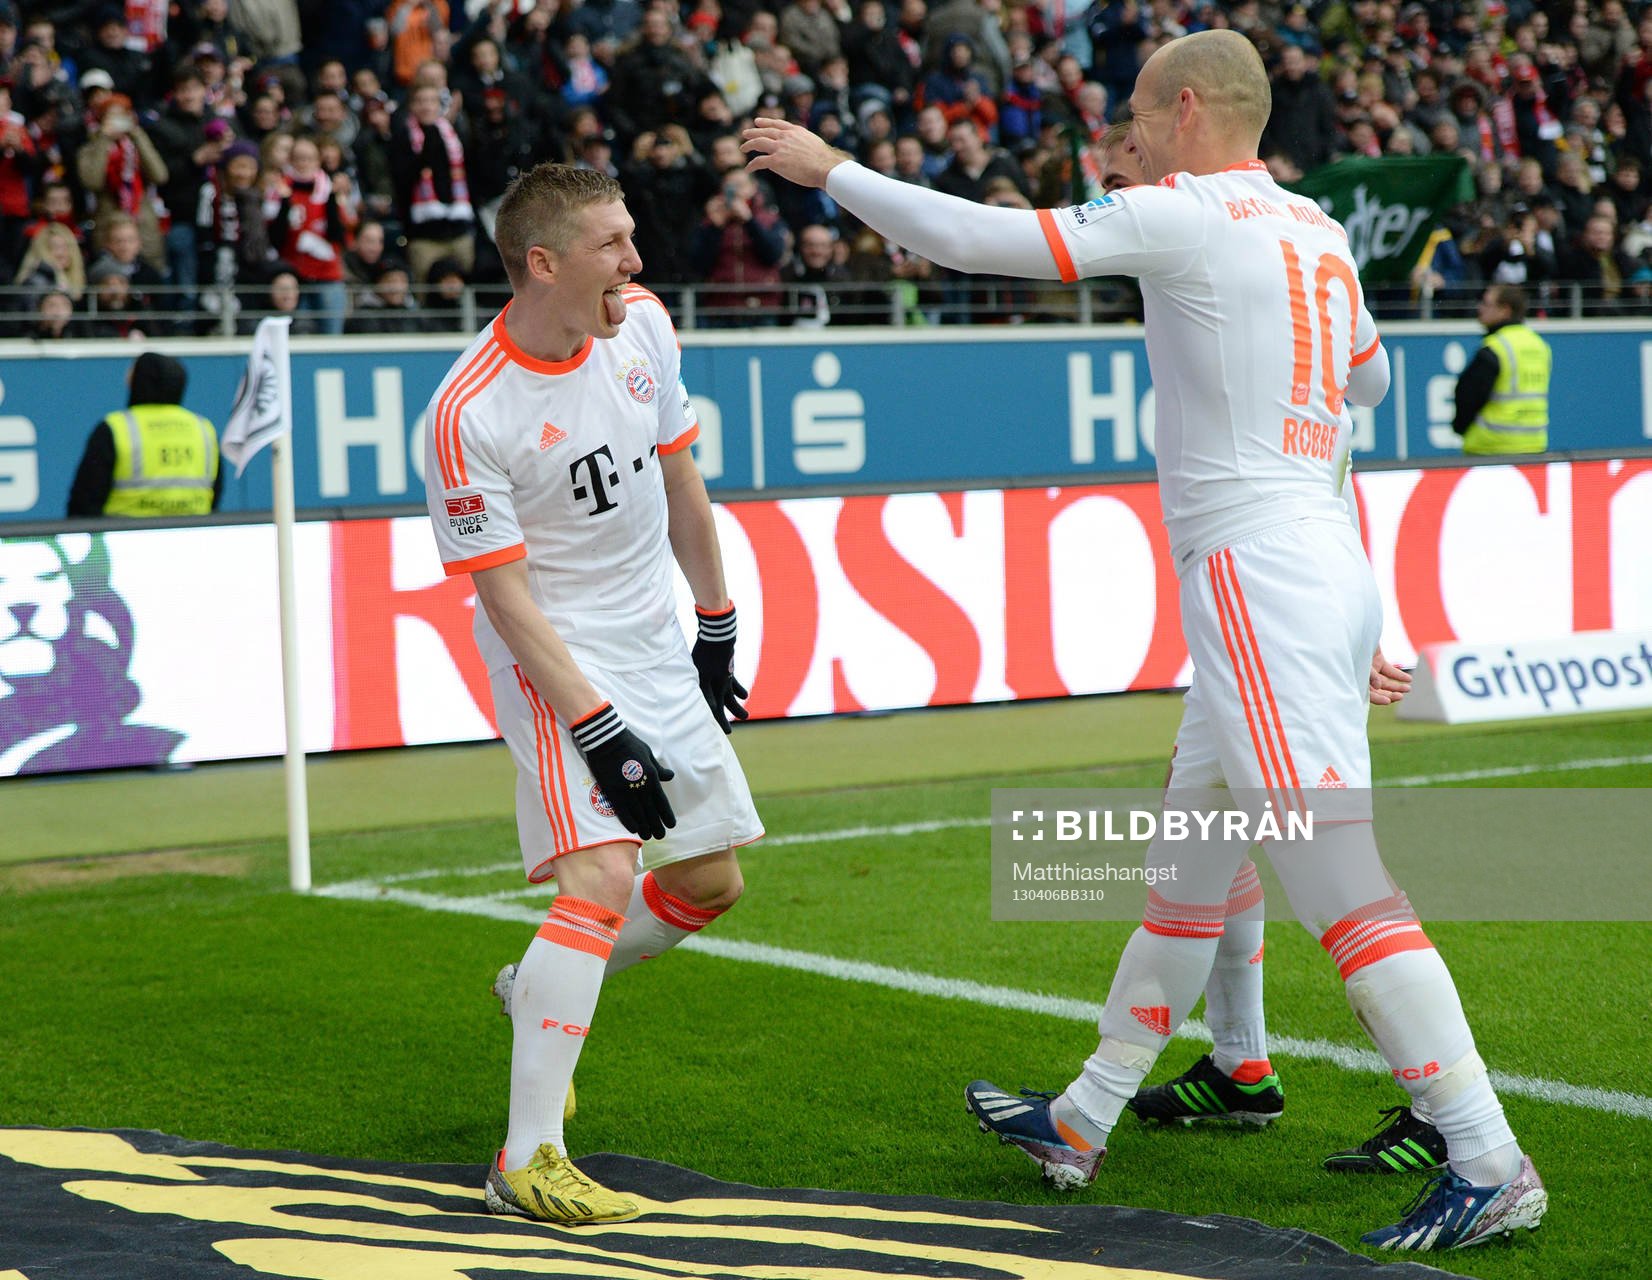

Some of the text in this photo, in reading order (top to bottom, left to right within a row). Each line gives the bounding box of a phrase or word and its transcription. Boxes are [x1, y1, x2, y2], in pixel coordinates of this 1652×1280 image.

[1279, 239, 1359, 415] 10
[450, 514, 488, 527] BUNDES
[458, 525, 483, 535] LIGA
